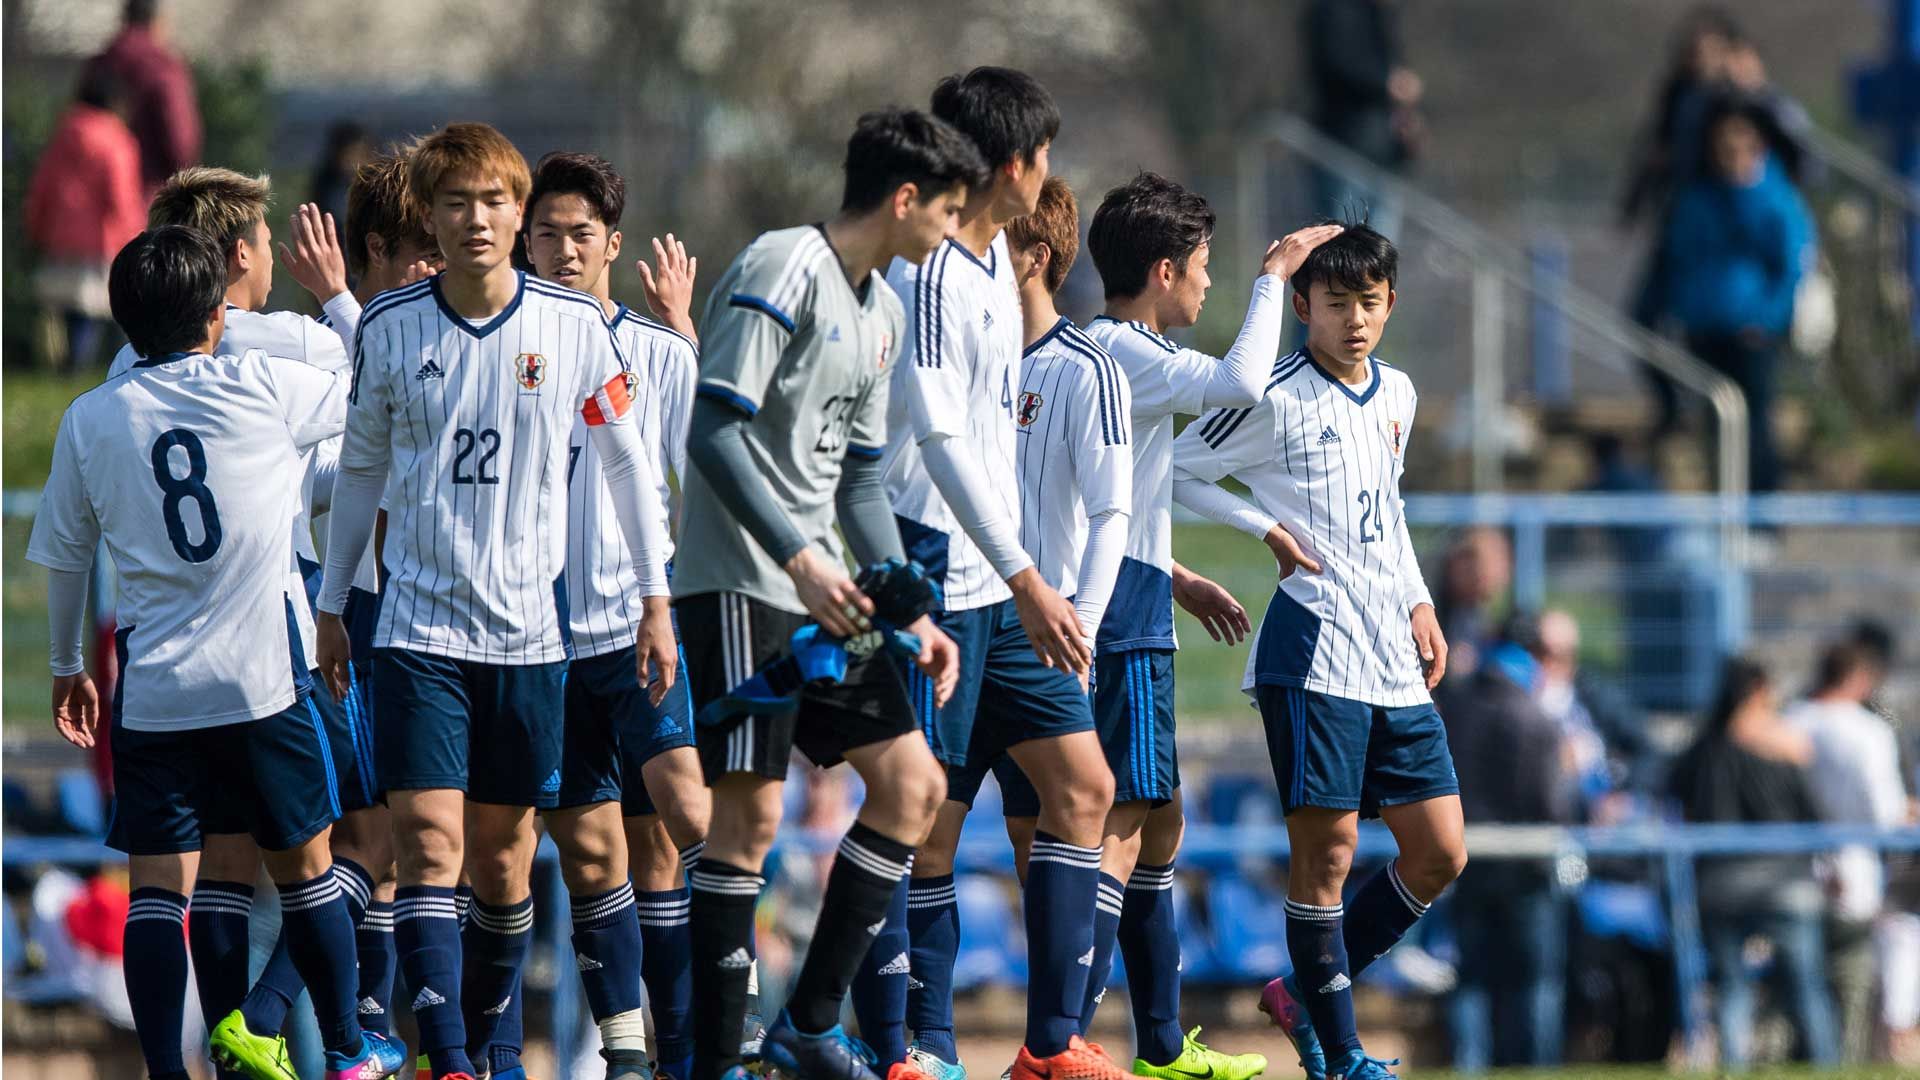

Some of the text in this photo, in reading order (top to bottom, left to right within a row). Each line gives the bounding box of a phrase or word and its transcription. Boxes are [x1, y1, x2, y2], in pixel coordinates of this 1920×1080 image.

[452, 428, 500, 485] 22
[1317, 436, 1342, 446] adidas
[151, 428, 223, 564] 8
[1357, 489, 1384, 543] 24
[878, 967, 911, 975] adida
